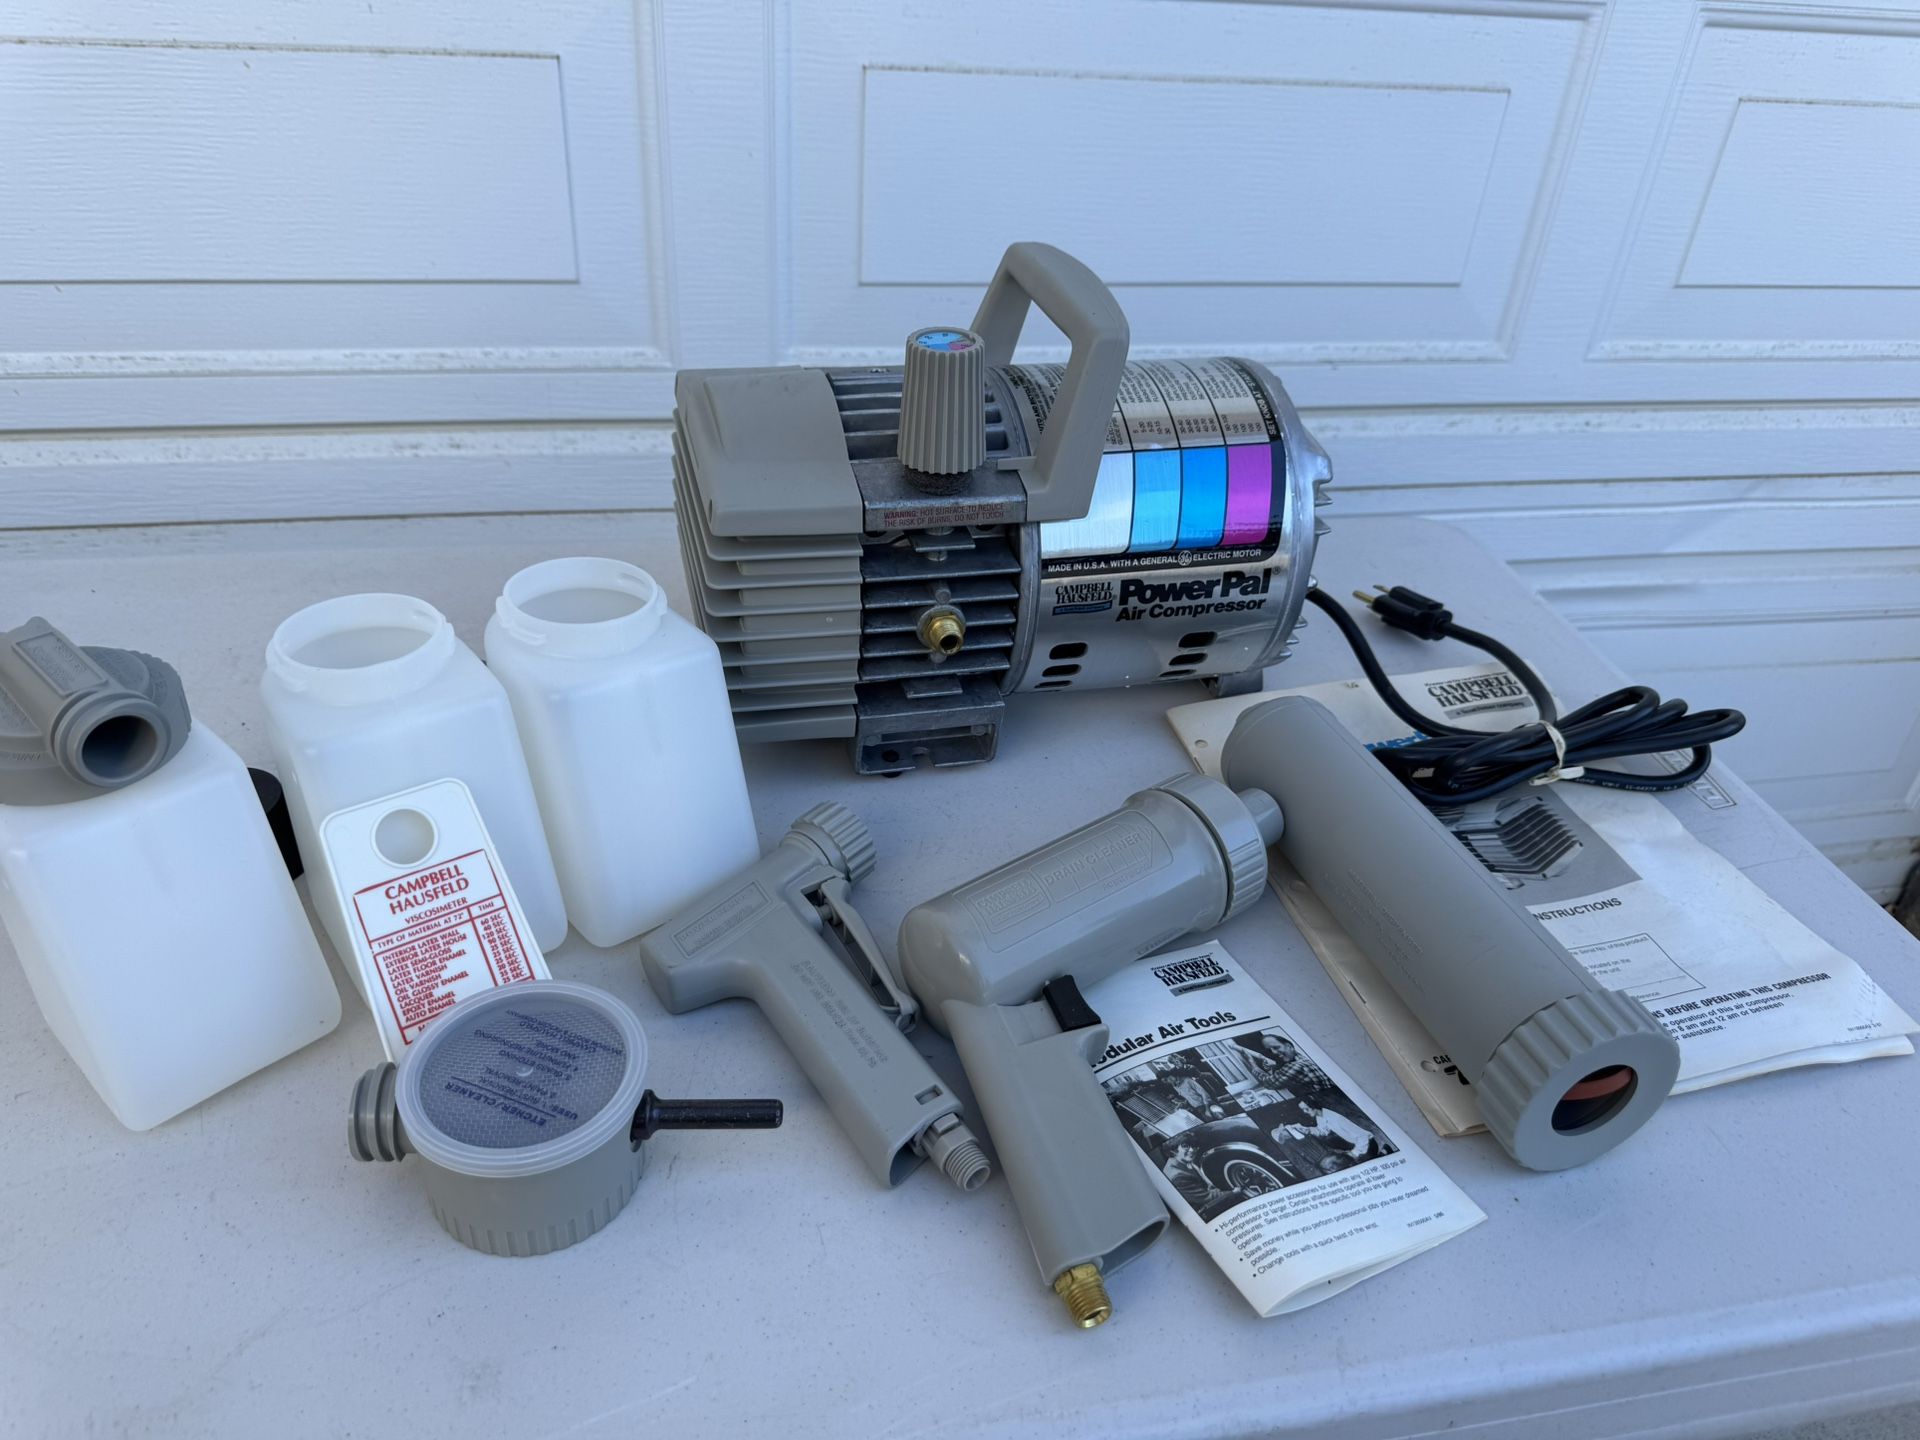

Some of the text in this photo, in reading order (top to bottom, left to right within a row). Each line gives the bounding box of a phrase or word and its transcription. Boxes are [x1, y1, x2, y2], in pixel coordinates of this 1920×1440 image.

[1257, 399, 1277, 435] SET KNOB
[884, 519, 897, 528] THE
[898, 518, 915, 526] RISK
[966, 513, 979, 521] NOT
[920, 509, 933, 517] HOT
[1048, 564, 1071, 572] MADE
[1083, 561, 1108, 570] U.S.A.
[1111, 560, 1131, 568] WITH
[1140, 556, 1177, 566] GENERAL
[1193, 553, 1231, 562] ELECTRIC
[1233, 549, 1261, 558] MOTOR
[1055, 581, 1113, 595] CAMPBELL
[1056, 592, 1113, 604] HAUSFELD
[1116, 607, 1146, 621] Air
[1149, 599, 1266, 618] Compressor
[1428, 675, 1517, 697] CAMPBELL
[1437, 686, 1523, 707] HAUSFELD
[1044, 860, 1085, 886] DRAIN
[1087, 833, 1143, 864] CLEANER
[385, 865, 463, 899] CAMPBELL
[390, 878, 469, 914] HAUSFELD
[478, 901, 494, 911] TIME
[405, 897, 467, 924] VISCOSIMETER
[490, 913, 504, 922] SEC.
[1532, 898, 1622, 921] NSTRUCTIONS
[378, 938, 394, 948] TYPE
[396, 934, 405, 942] OF
[408, 921, 441, 937] MATERIAL
[482, 925, 509, 939] 120 SEC.
[492, 919, 507, 928] SEC.
[383, 929, 460, 961] INTERIOR LATEX WALL
[490, 938, 514, 951] 25 SEC.
[497, 932, 512, 941] SEC.
[385, 934, 467, 968] EXTERIOR LATEX HOUSE
[388, 947, 452, 975] LATEX SEMI-GLOSS
[493, 945, 516, 958] 25 SEC.
[504, 951, 519, 961] SEC.
[390, 949, 466, 981] LATEX FLOOR ENAMEL
[507, 958, 522, 967] SEC.
[509, 964, 524, 973] SEC.
[1154, 957, 1219, 978] CAMPBELL
[392, 964, 447, 988] LATEX VARNISH
[395, 973, 441, 995] OIL VARNISH
[512, 970, 526, 980] SEC.
[1161, 966, 1224, 986] HAUSFELD
[397, 971, 469, 1002] OIL GLOSSY ENAMEL
[1664, 973, 1831, 1015] BEFORE OPERATING THIS COMPRESSOR
[400, 991, 434, 1009] LACQUER
[402, 991, 455, 1016] EPOXY ENAMEL
[404, 999, 456, 1022] AUTO ENAMEL
[1669, 1013, 1708, 1026] operation
[1699, 1018, 1715, 1027] and
[1749, 1002, 1784, 1014] between
[1091, 1011, 1236, 1068] dular Air Tools
[1681, 1025, 1726, 1039] assistance.
[444, 1082, 547, 1127] ETCHER/CLEANER
[1219, 1203, 1267, 1229] Hi-performance
[1267, 1197, 1285, 1207] power
[1225, 1214, 1262, 1236] compressor
[1288, 1198, 1310, 1207] Certain
[1231, 1223, 1263, 1244] pressures.
[1277, 1206, 1311, 1220] instructions
[1329, 1194, 1351, 1204] specific
[1362, 1186, 1373, 1194] you
[1243, 1245, 1262, 1258] Save
[1262, 1235, 1284, 1247] money
[1284, 1229, 1300, 1238] while
[1311, 1218, 1334, 1229] perform
[1334, 1206, 1367, 1222] professional
[1379, 1200, 1390, 1208] you
[1389, 1195, 1405, 1203] never
[1405, 1186, 1429, 1198] dreamed
[1250, 1247, 1278, 1266] possible.
[1257, 1256, 1284, 1274] Change
[1283, 1249, 1301, 1258] tools
[1300, 1244, 1313, 1252] with
[1318, 1237, 1335, 1247] quick
